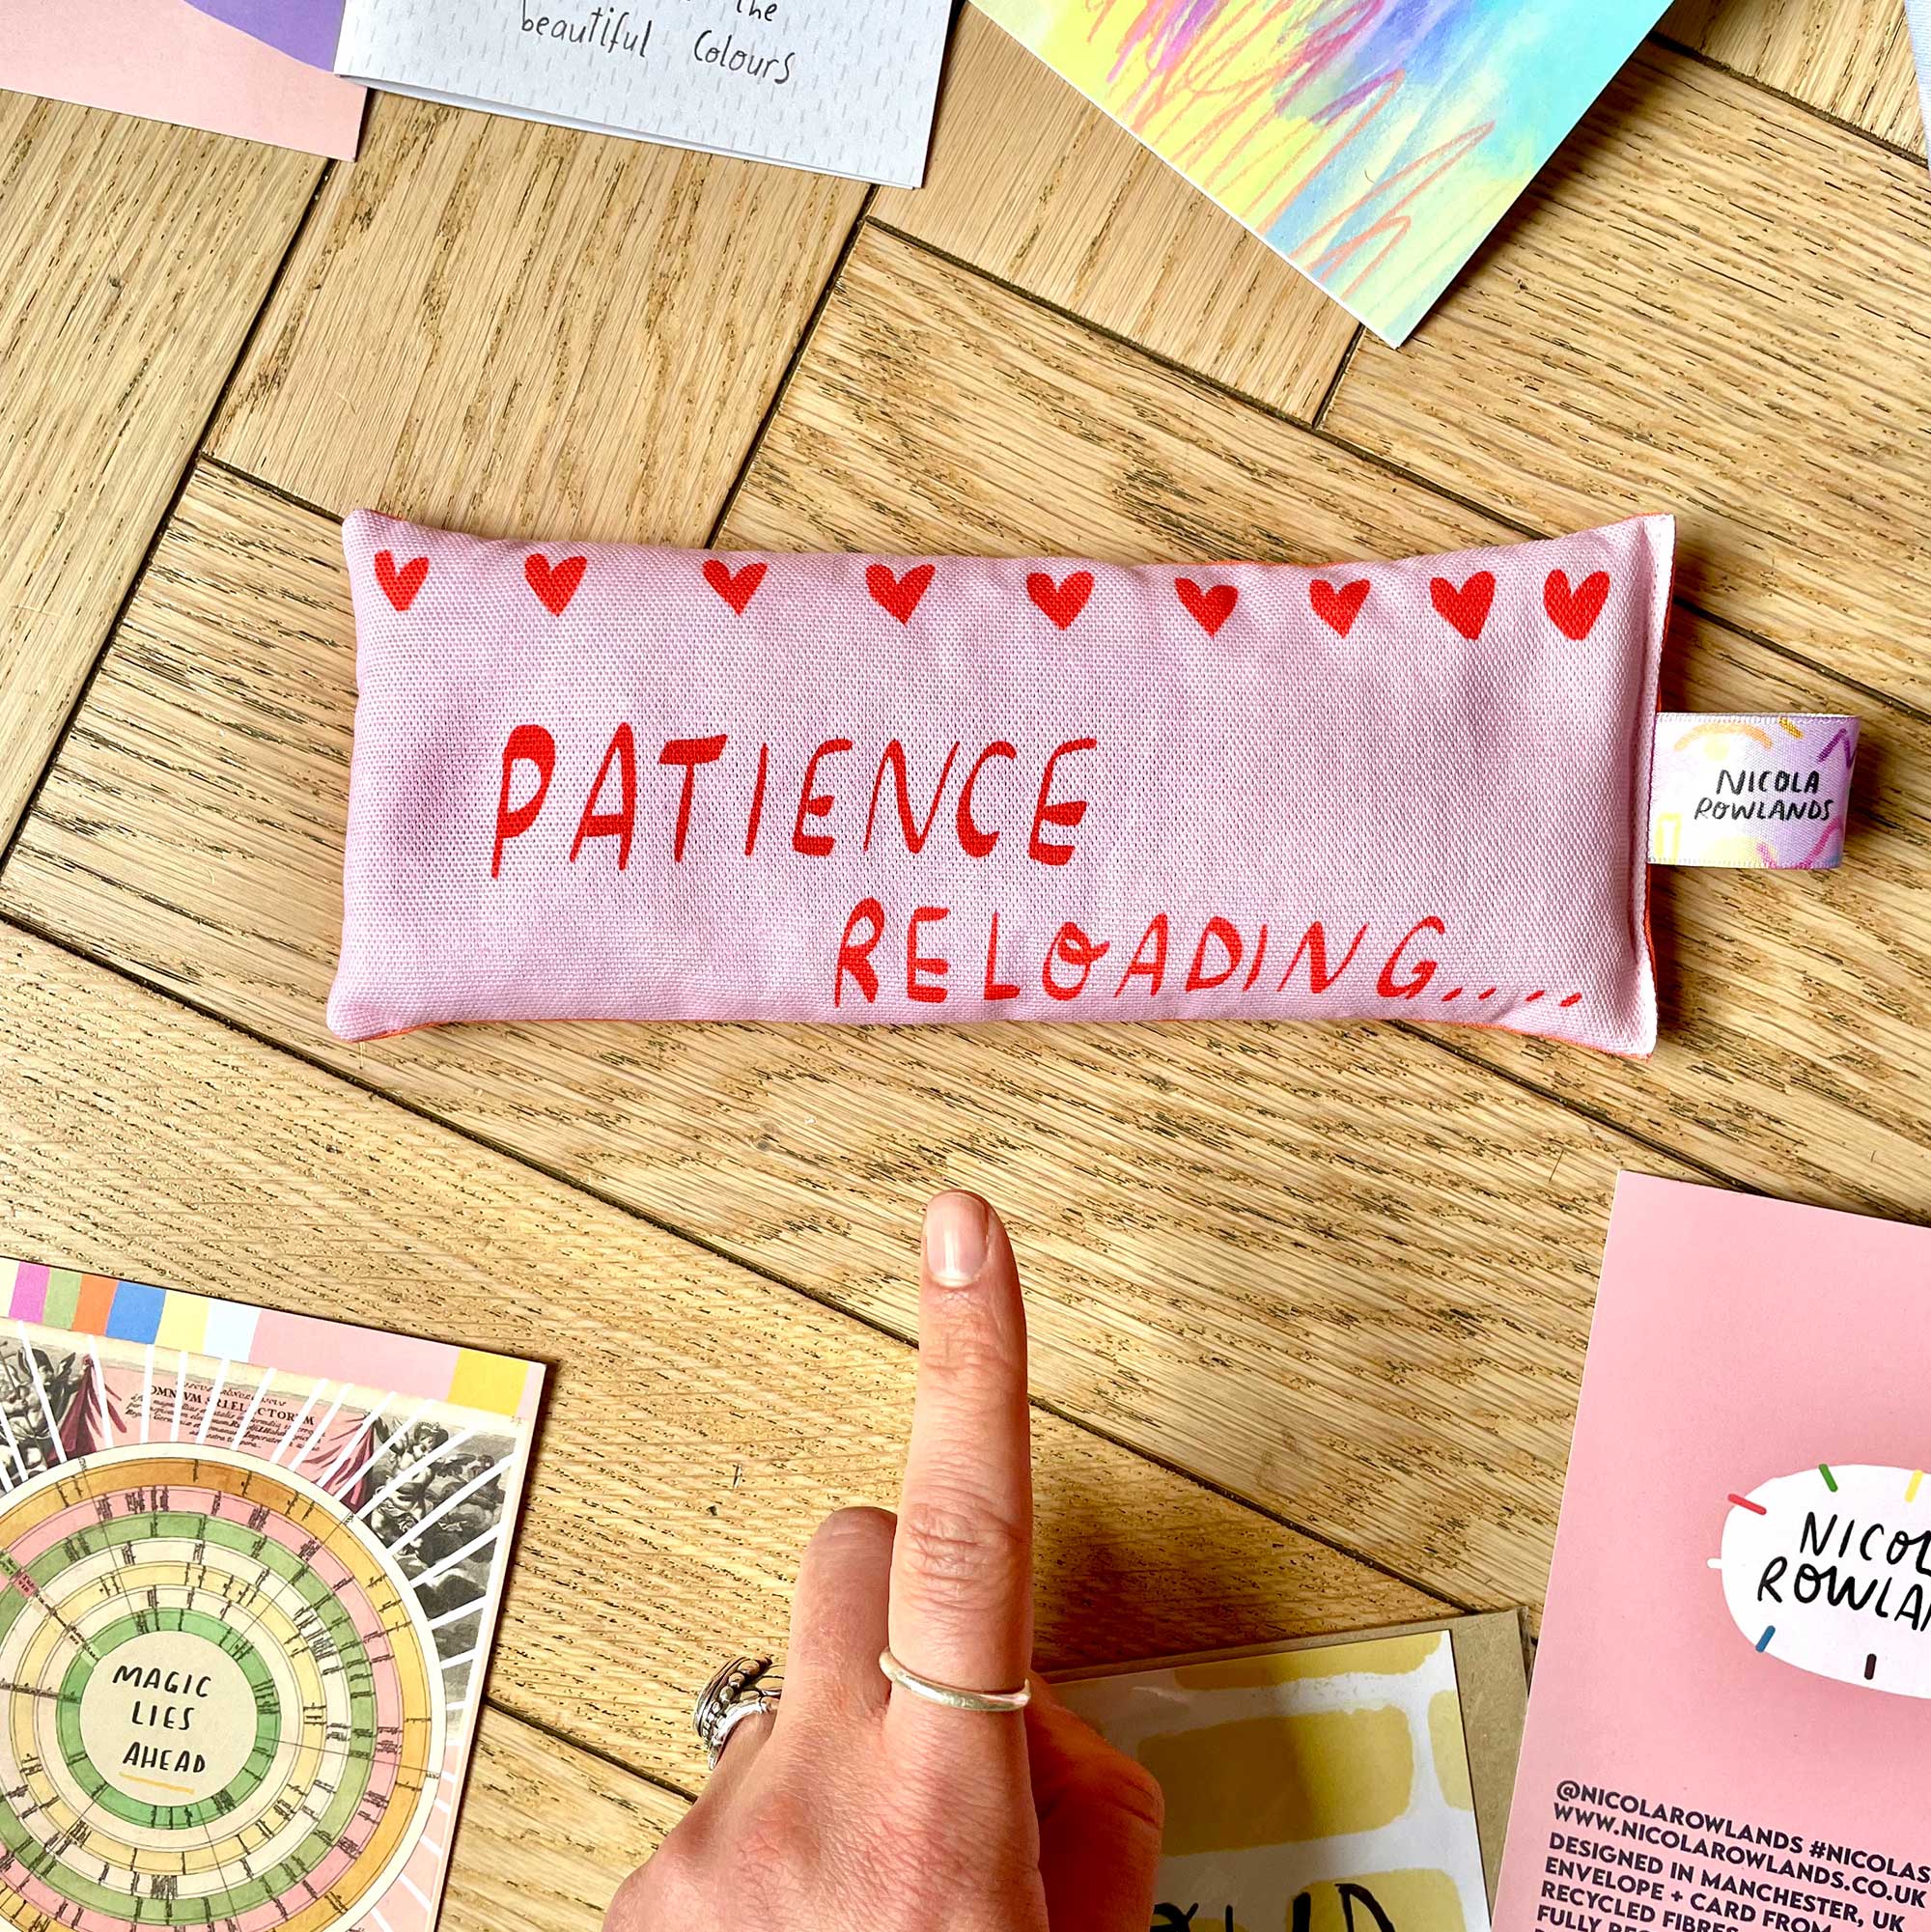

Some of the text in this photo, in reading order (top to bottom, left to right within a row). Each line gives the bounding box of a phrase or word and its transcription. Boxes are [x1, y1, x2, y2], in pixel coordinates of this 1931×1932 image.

[521, 0, 795, 84] beautiful Colours
[490, 721, 1097, 879] PATIENCE
[1693, 797, 1834, 821] ROWLANDS
[1716, 769, 1820, 795] NICOLA
[1799, 1511, 1931, 1578] NICOL
[1757, 1555, 1931, 1632] ROWLA
[112, 1665, 211, 1697] MAGIC
[131, 1700, 194, 1730] LIES
[123, 1741, 206, 1773] AHEAD
[1553, 1802, 1927, 1908] WWW.NICOLAROWLANDS.CO.UK
[1555, 1779, 1931, 1884] @NICOLAROWLANDS #NICOLAS
[1541, 1879, 1656, 1922] RECYCLED
[1545, 1855, 1832, 1932] ENVELOPE + CARD FROM
[1549, 1832, 1905, 1932] DESIGNED IN MANCHESTER, UK
[1536, 1904, 1602, 1932] FULLY
